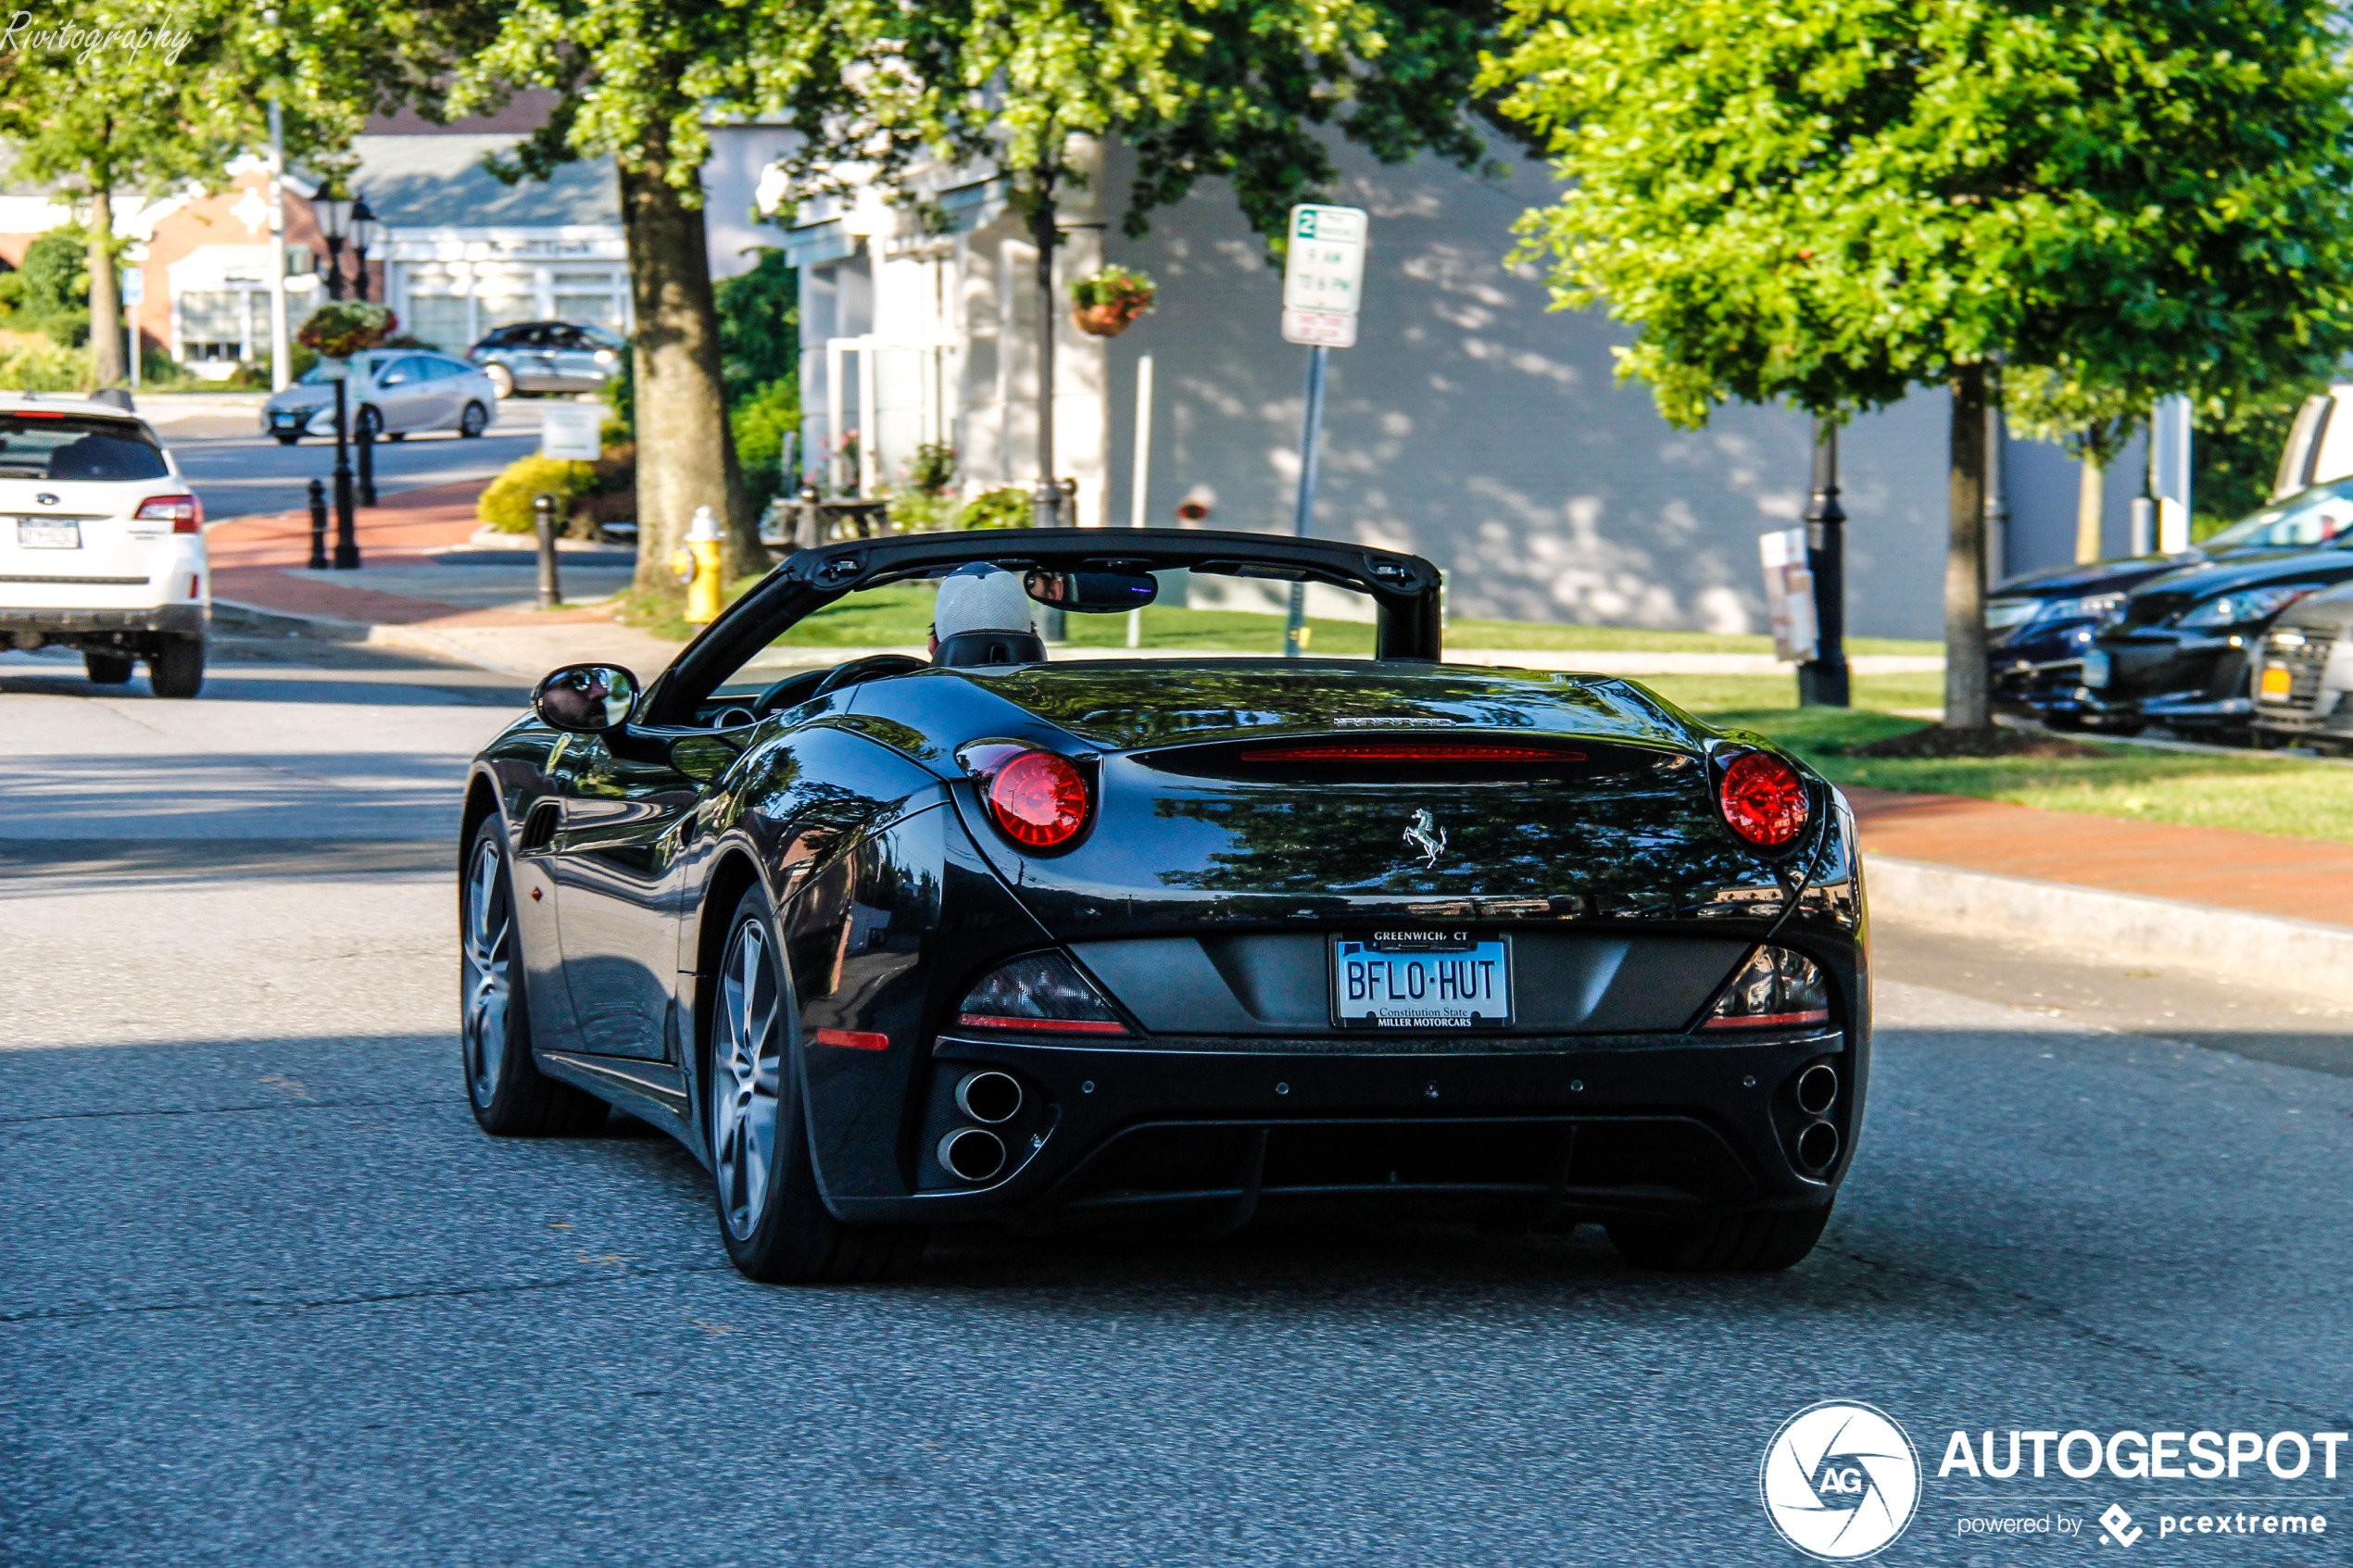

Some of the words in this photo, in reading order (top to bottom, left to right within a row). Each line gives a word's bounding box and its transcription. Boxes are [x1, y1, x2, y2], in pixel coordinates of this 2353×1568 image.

[1298, 212, 1315, 235] 2
[1374, 932, 1446, 940] GREENWICH,
[1453, 932, 1467, 940] CT
[1379, 1008, 1441, 1017] Constitution
[1443, 1008, 1468, 1017] State
[1378, 1018, 1413, 1027] MILLER
[1414, 1018, 1472, 1027] MOTORCARS
